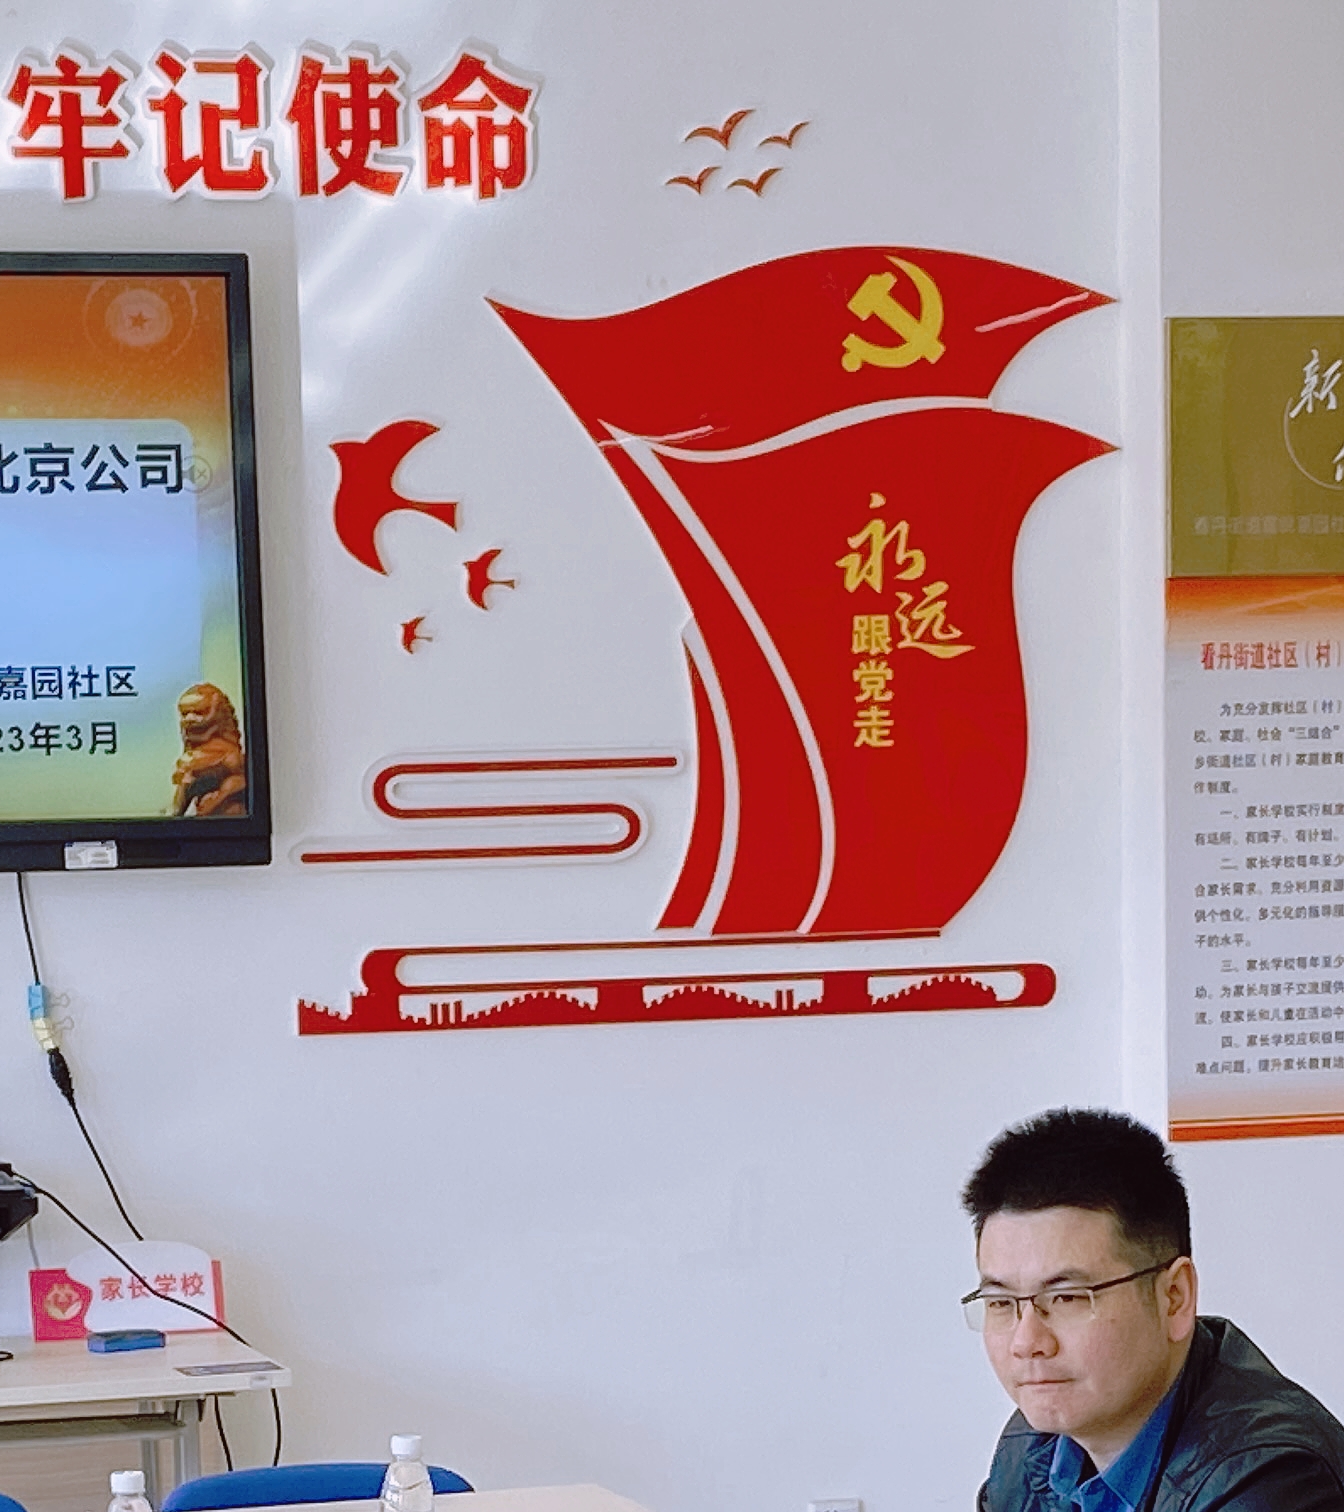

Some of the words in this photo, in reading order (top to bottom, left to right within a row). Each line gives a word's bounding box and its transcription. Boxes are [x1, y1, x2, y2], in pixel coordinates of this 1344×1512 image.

[8, 50, 536, 201] 牢记使命
[834, 491, 977, 660] 永远
[850, 614, 895, 748] 跟党走
[99, 1271, 206, 1301] 家长学校
